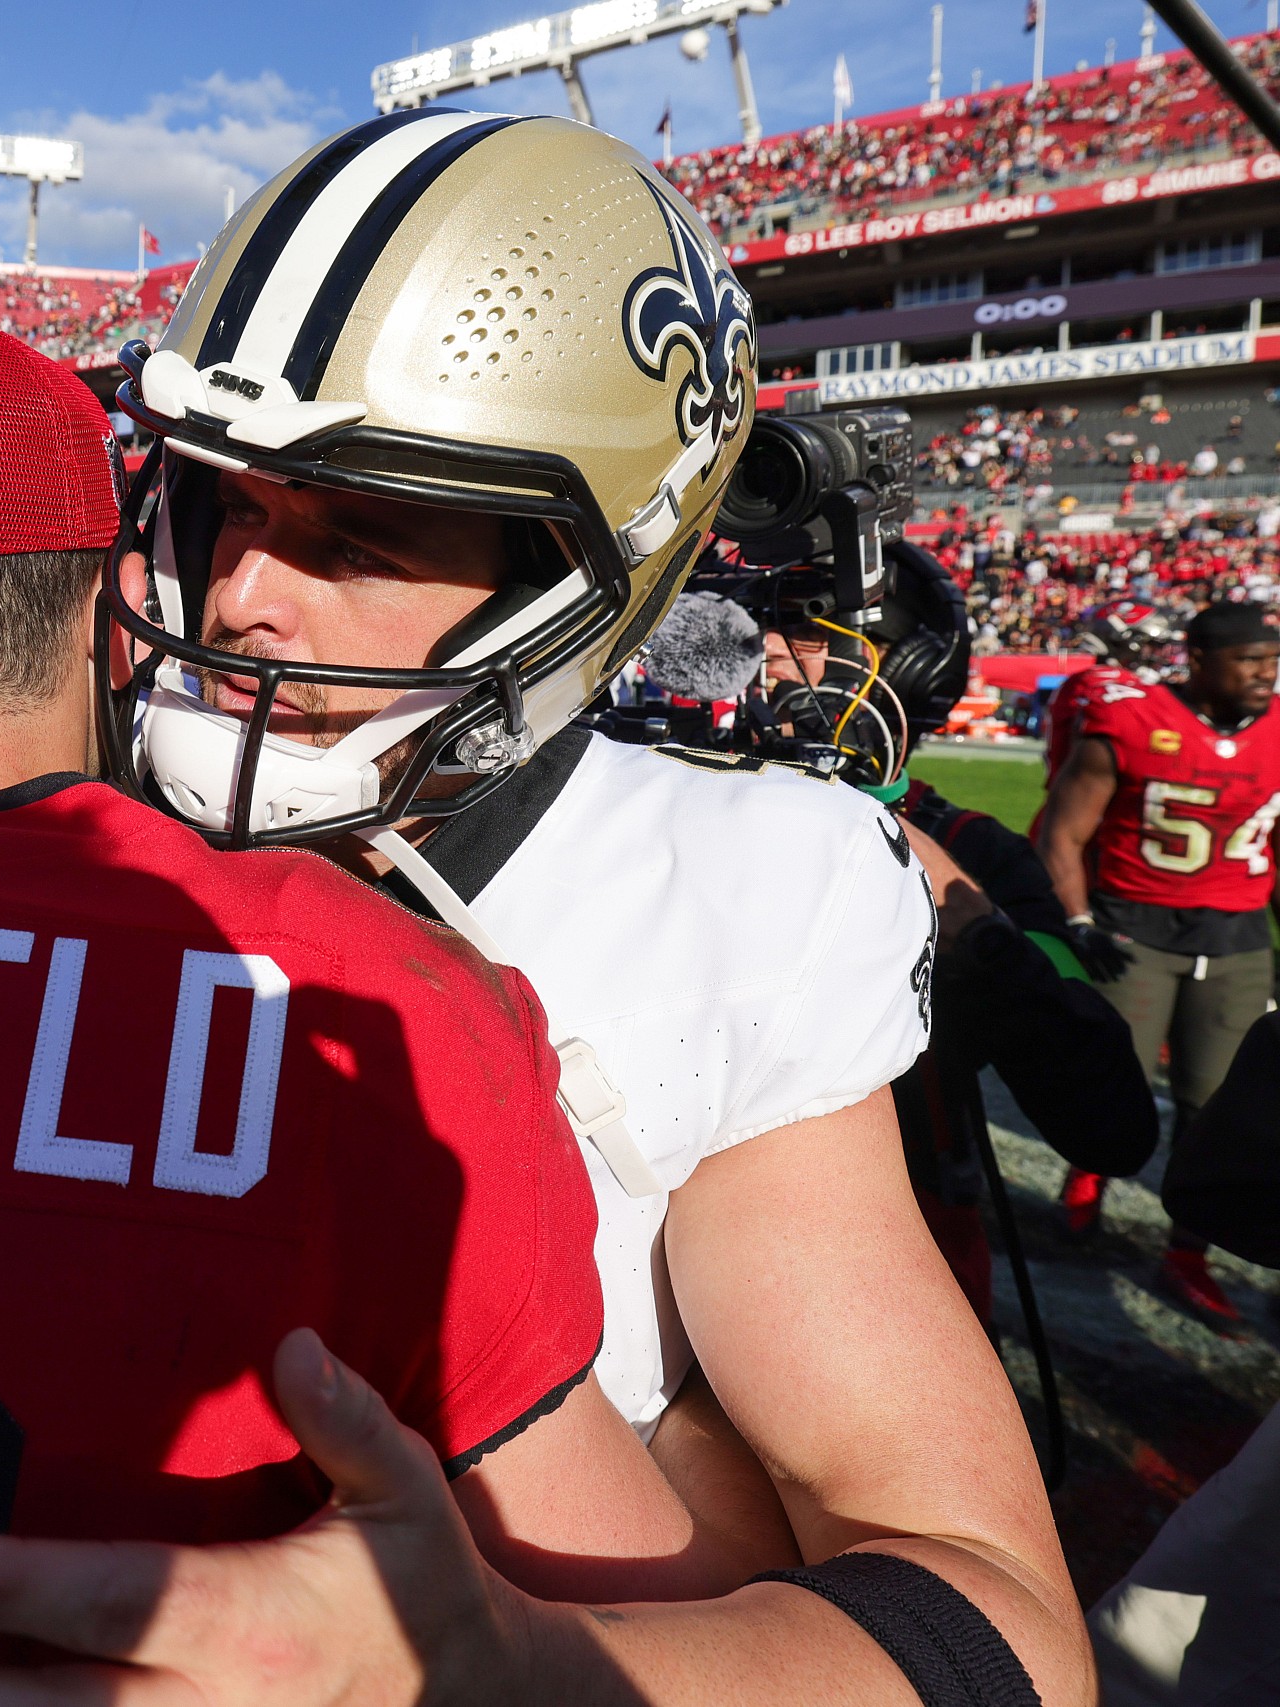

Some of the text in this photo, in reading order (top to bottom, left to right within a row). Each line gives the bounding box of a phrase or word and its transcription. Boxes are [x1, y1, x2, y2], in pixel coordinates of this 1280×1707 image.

[815, 223, 863, 250] LEE
[865, 213, 920, 243] ROY
[922, 195, 1035, 233] SELMON
[973, 295, 1068, 324] 0:00
[824, 334, 1250, 401] RAYMOND JAMES STADIUM
[1140, 780, 1280, 876] 54
